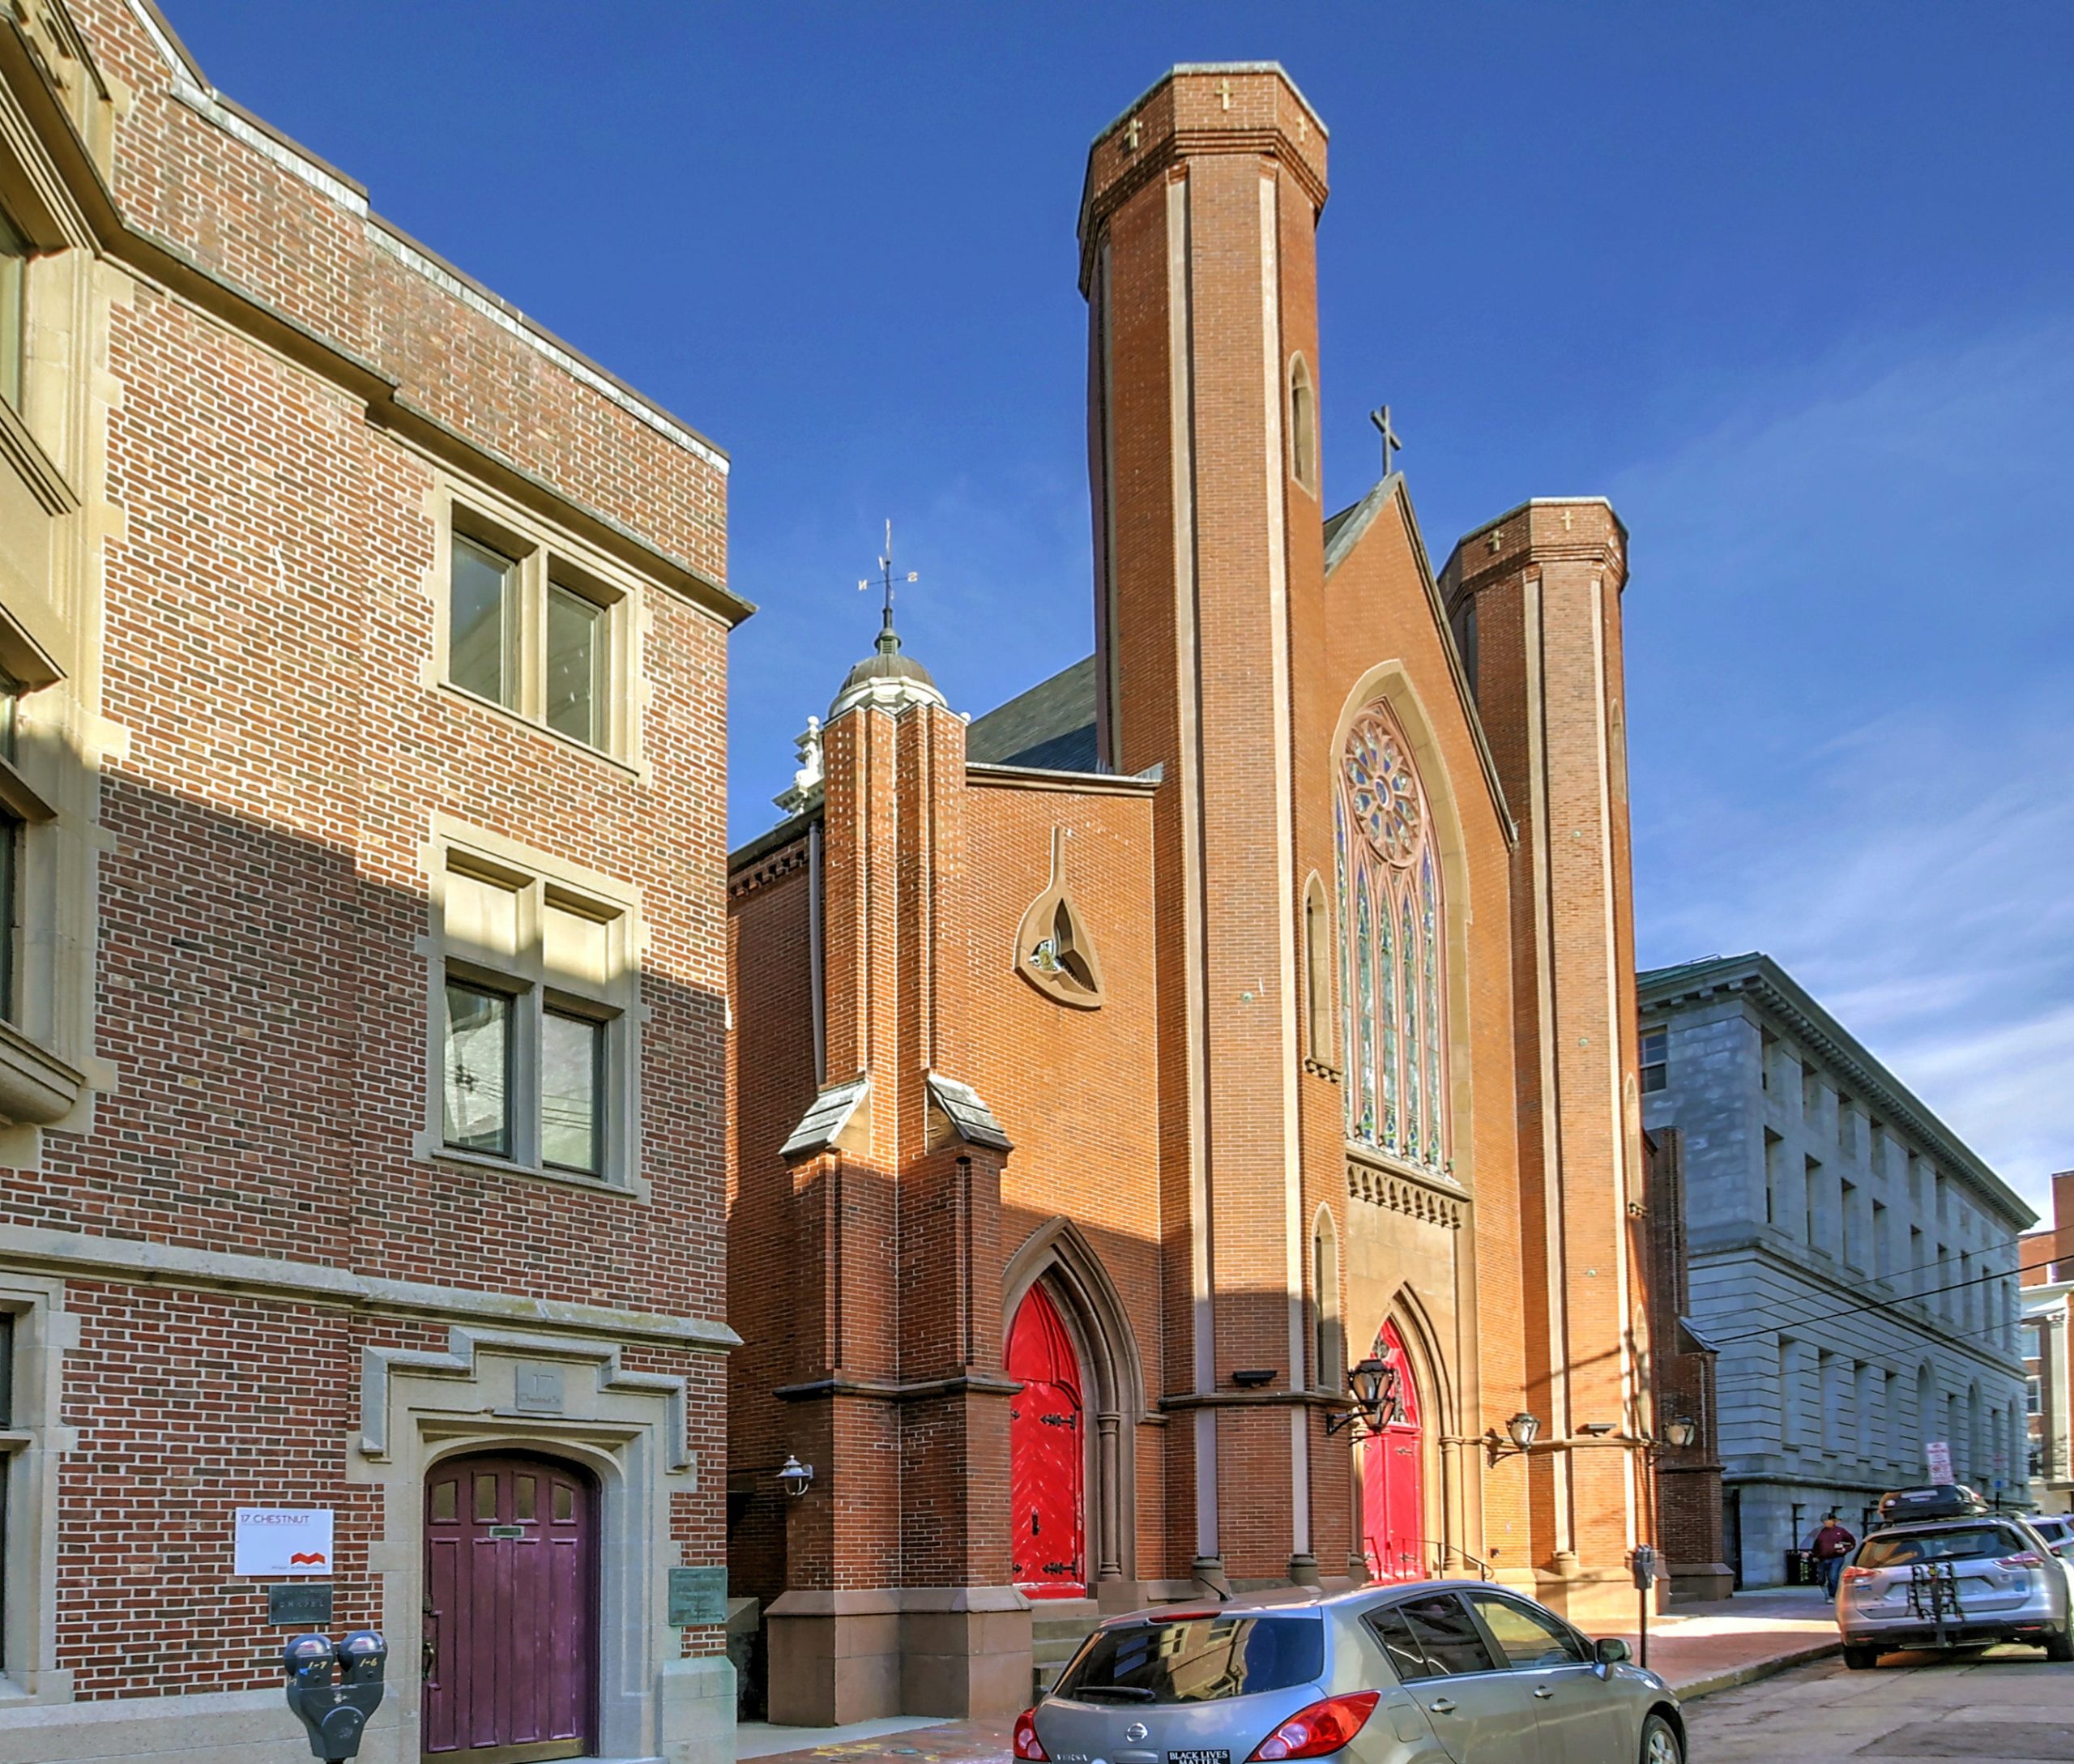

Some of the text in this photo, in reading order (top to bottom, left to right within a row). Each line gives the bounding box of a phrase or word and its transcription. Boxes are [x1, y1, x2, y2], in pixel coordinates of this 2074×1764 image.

[532, 1374, 554, 1394] 17
[241, 1514, 309, 1524] 17 CHESTNUT
[1169, 1750, 1228, 1760] BLACK LIVES
